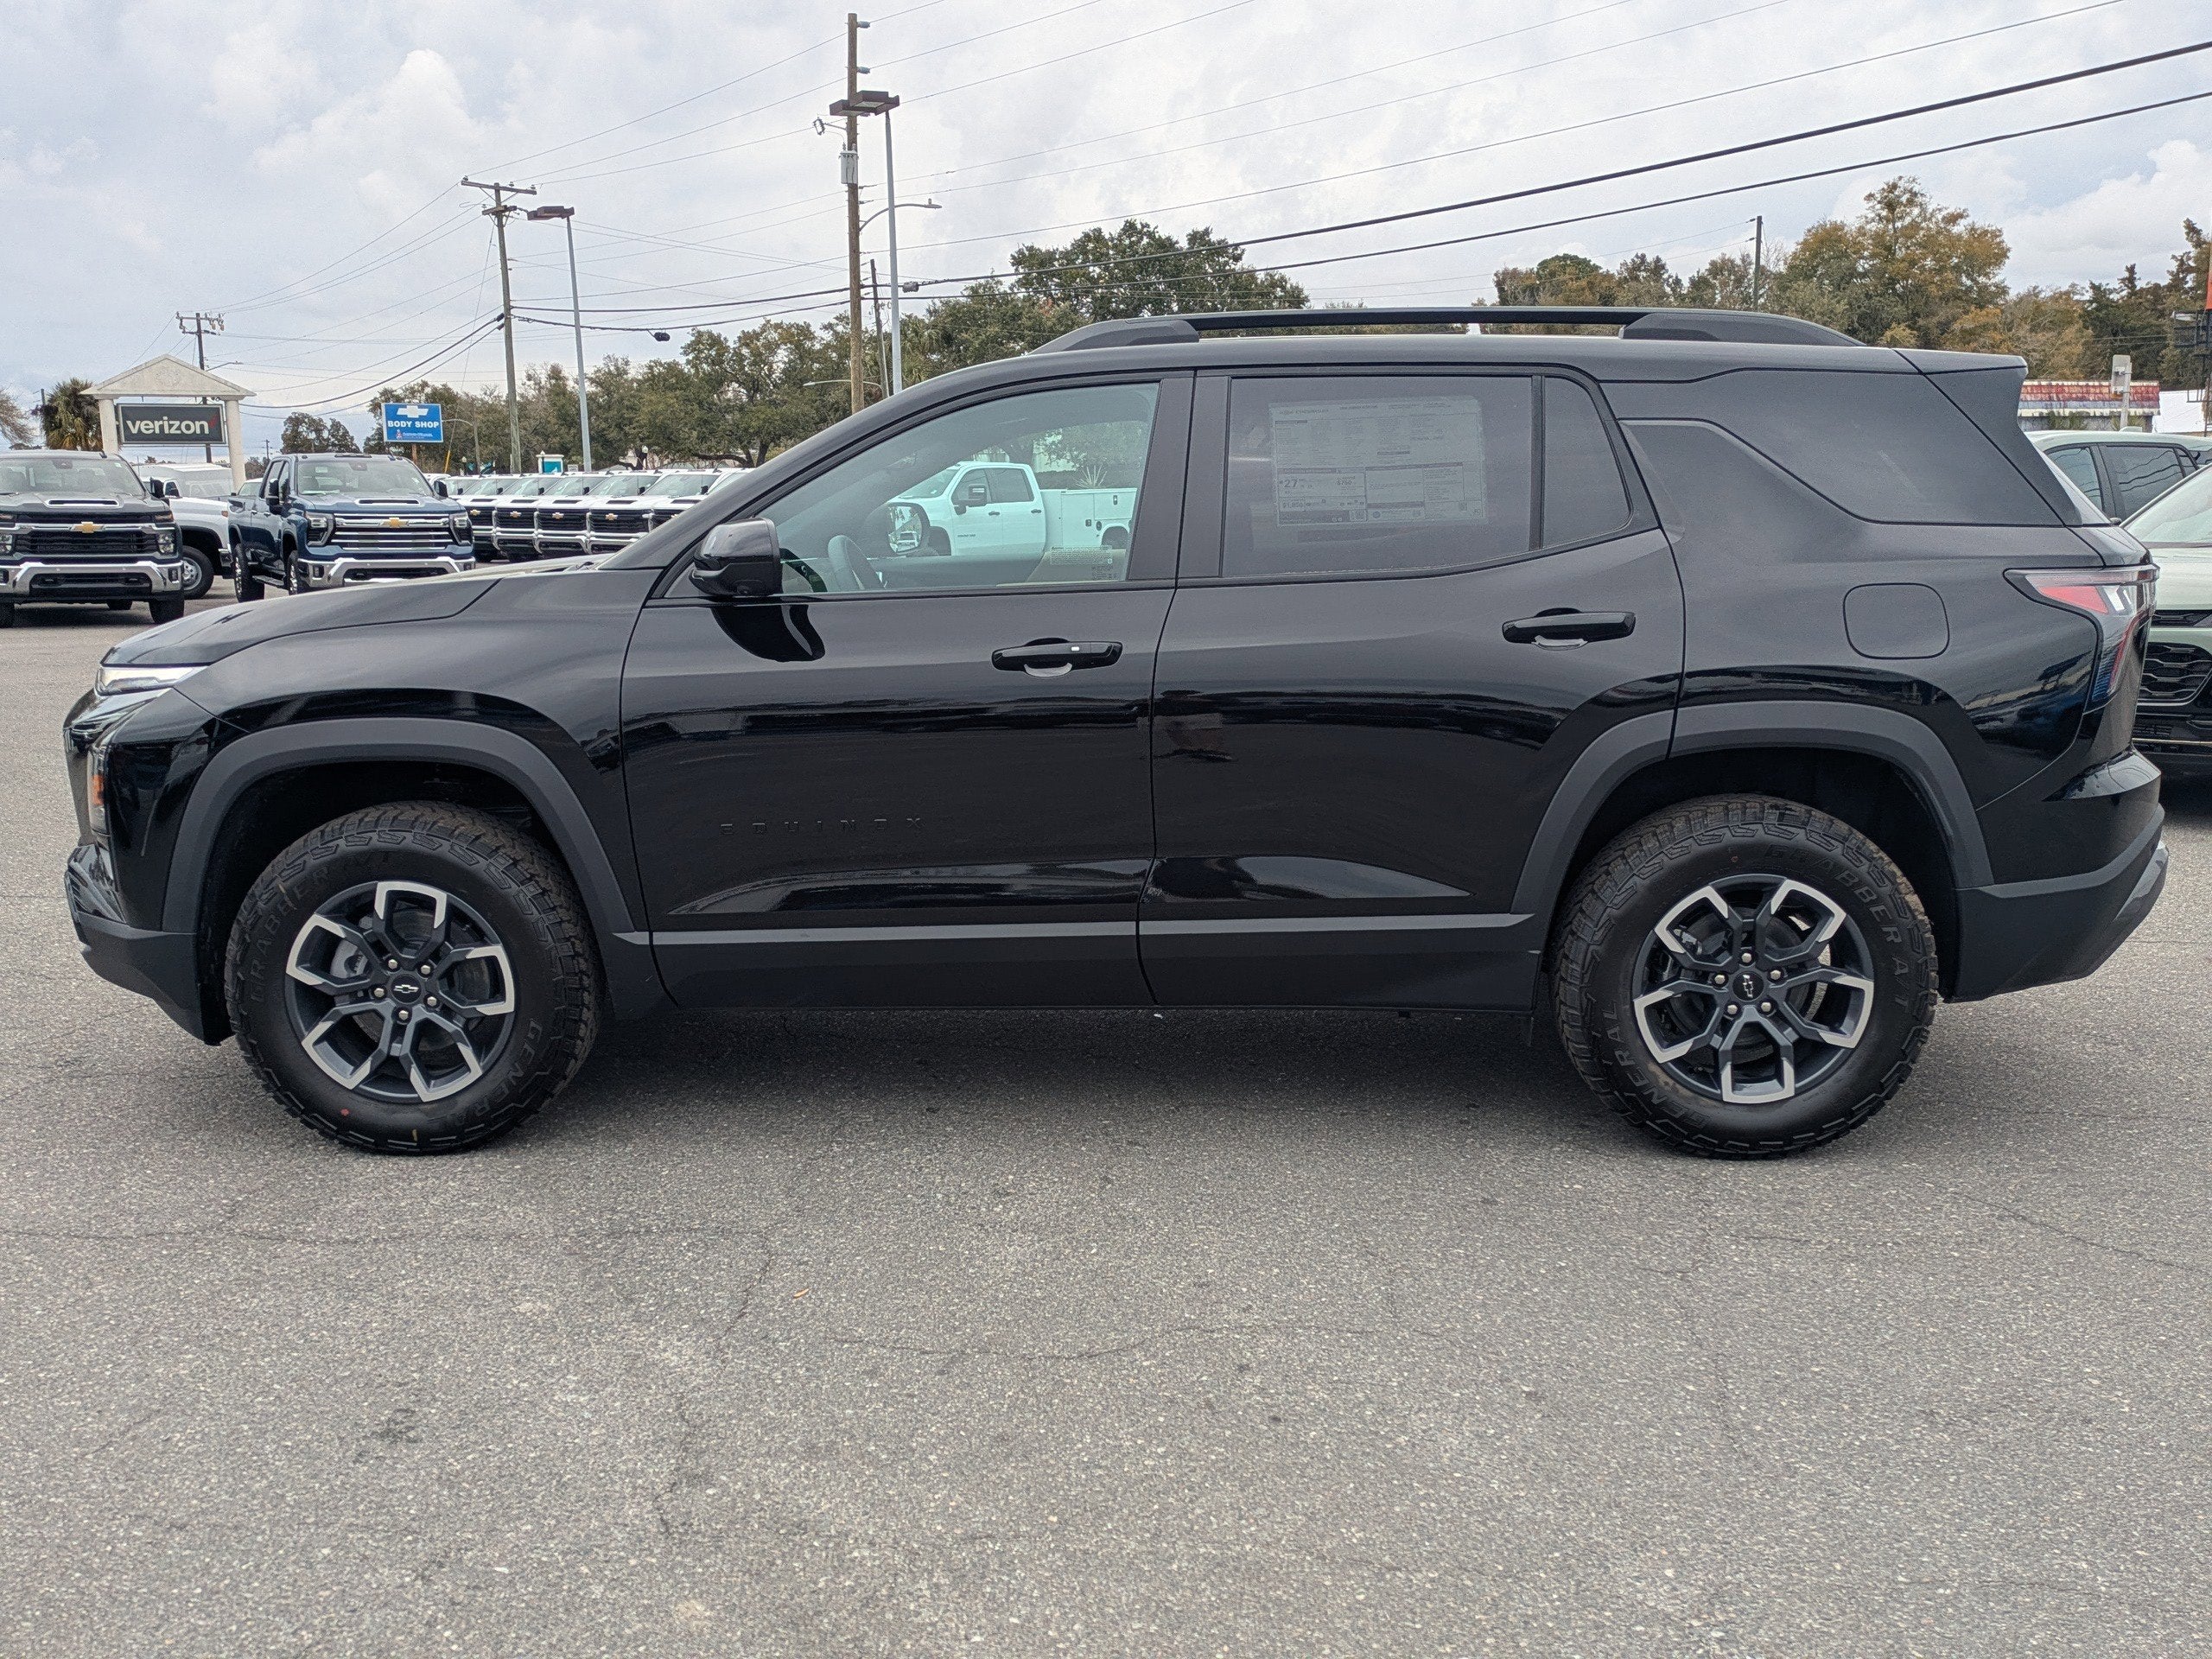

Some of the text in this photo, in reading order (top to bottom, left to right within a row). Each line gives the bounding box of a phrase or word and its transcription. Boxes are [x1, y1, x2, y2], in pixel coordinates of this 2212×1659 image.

[126, 416, 209, 435] verizon
[720, 817, 923, 836] EQUINOX
[250, 866, 329, 1003] GRABBER
[1764, 843, 1904, 944] GRABBER
[1602, 1002, 1709, 1129] GENERAL
